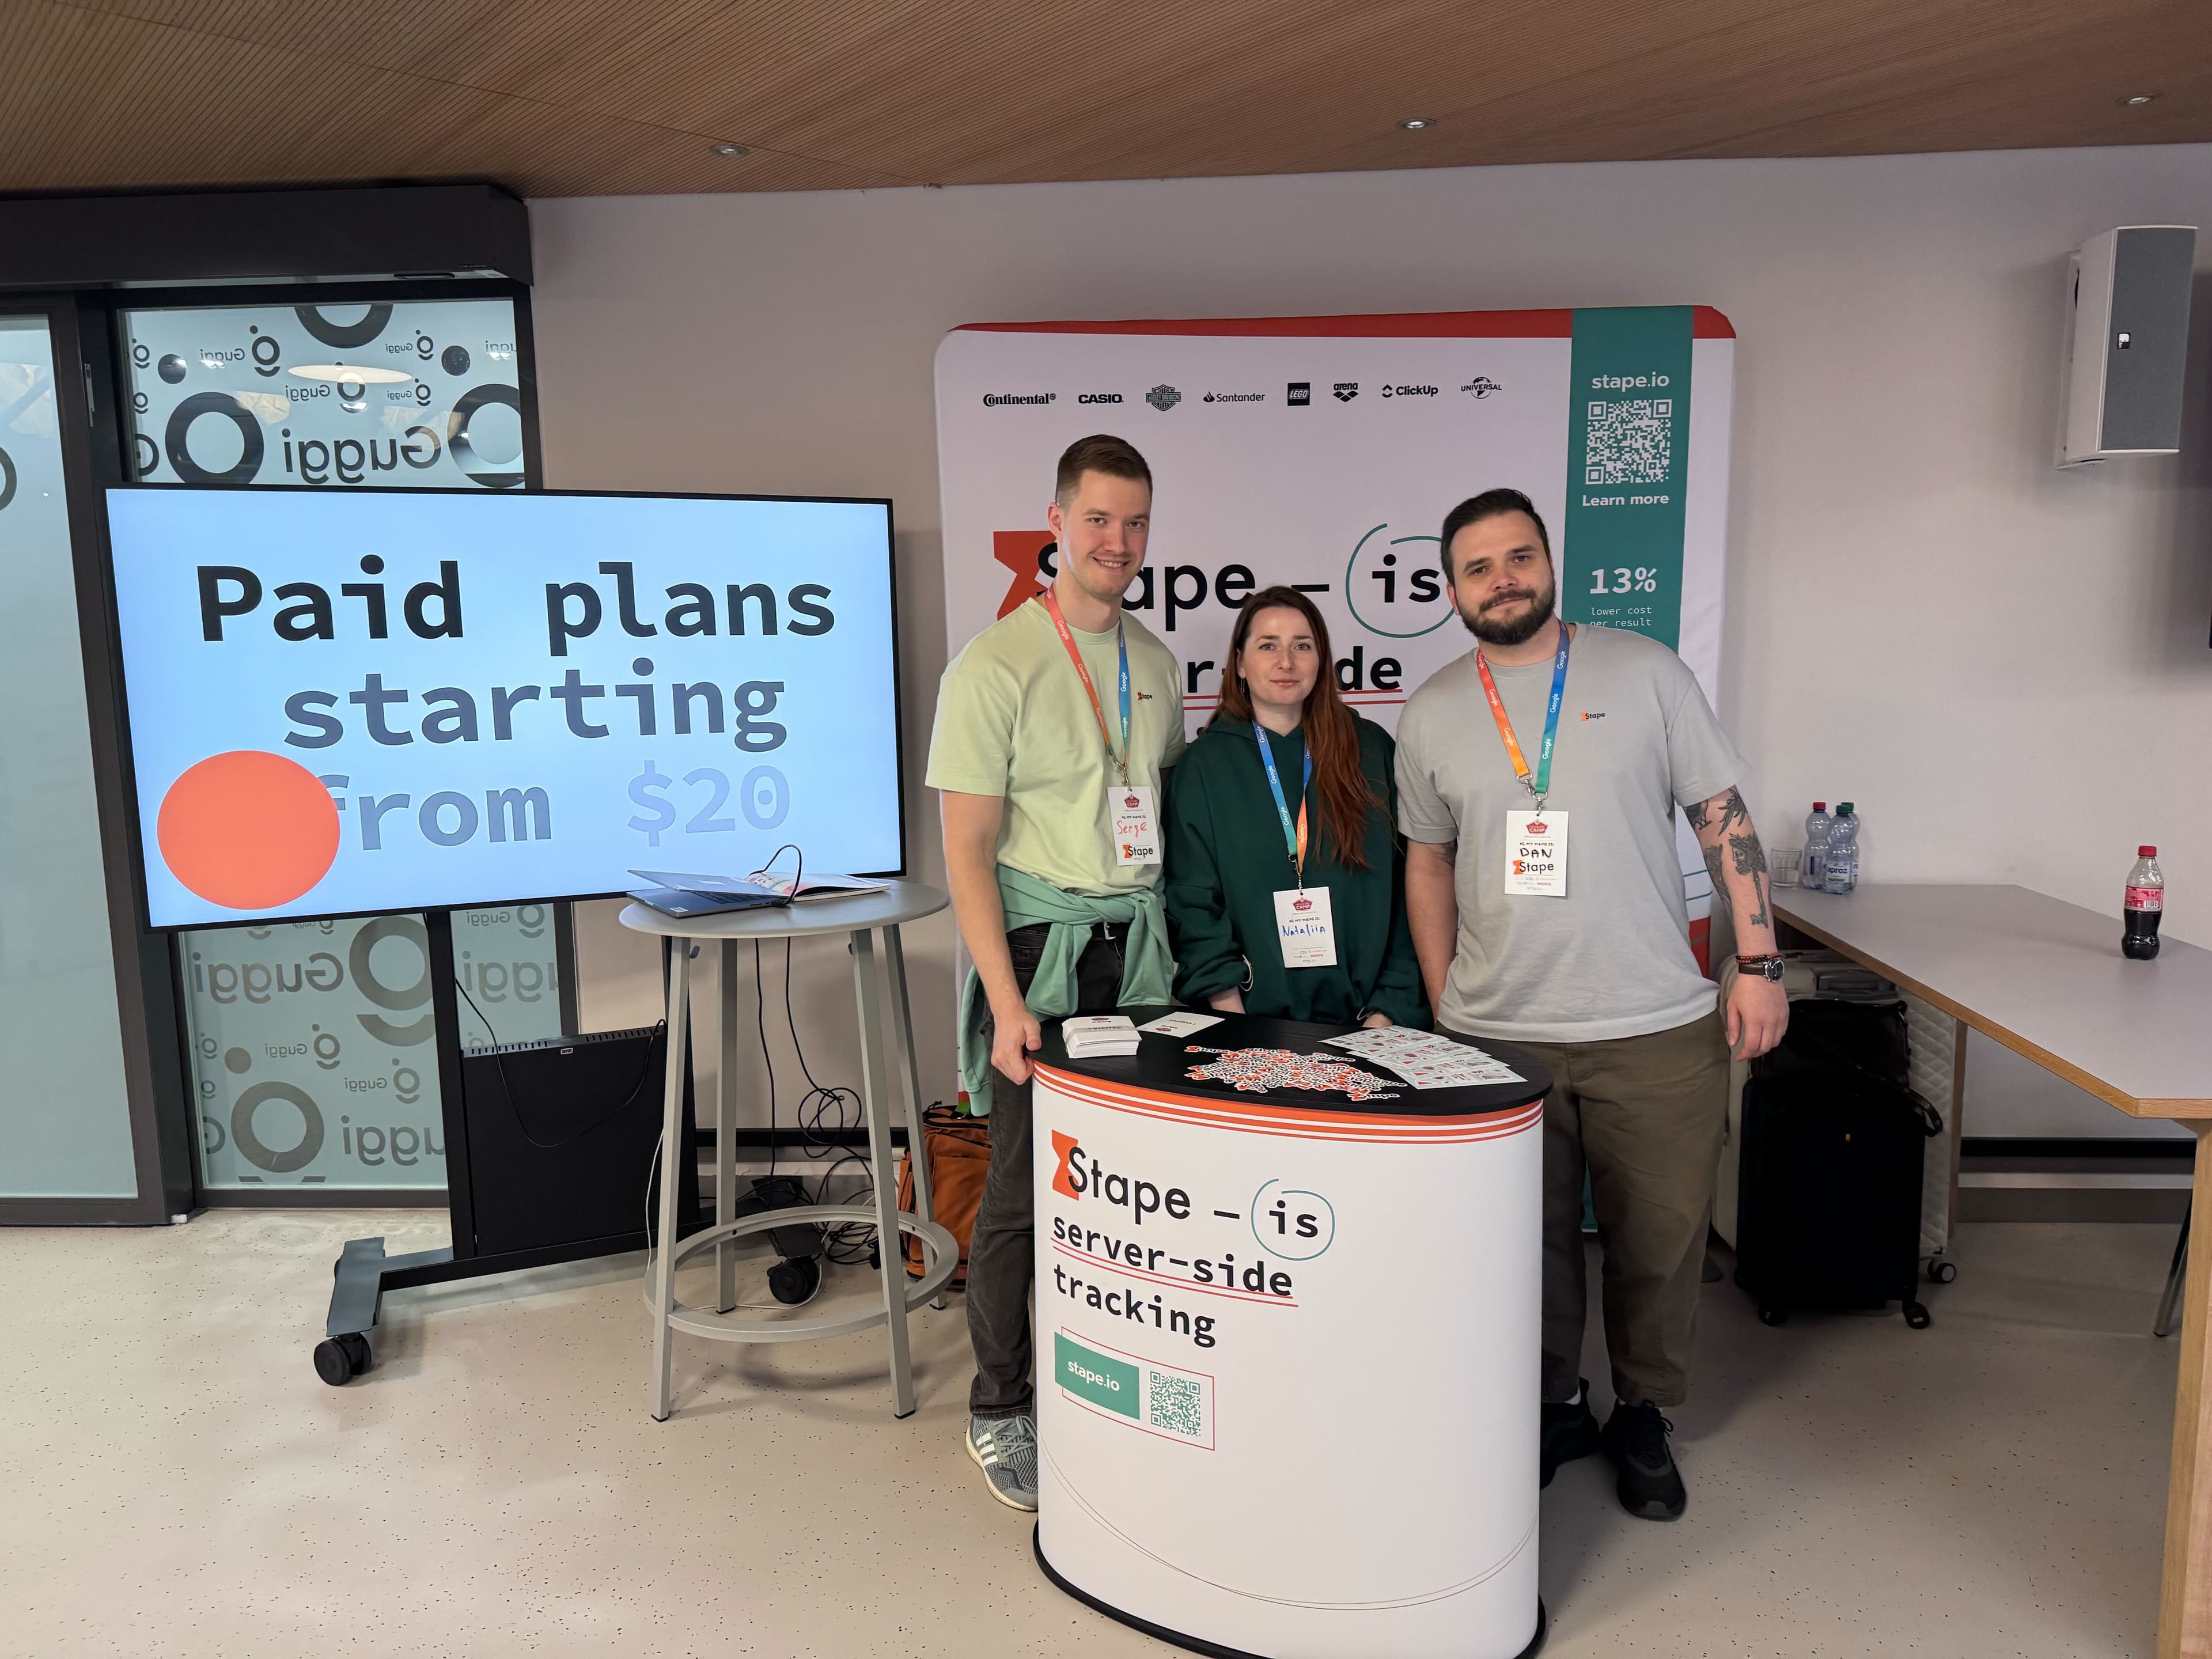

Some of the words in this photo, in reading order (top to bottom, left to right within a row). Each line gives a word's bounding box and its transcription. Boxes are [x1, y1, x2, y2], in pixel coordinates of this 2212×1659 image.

[1334, 382, 1358, 391] arena
[1396, 385, 1438, 397] ClickUp
[1461, 384, 1502, 392] UNIVERSAL
[1592, 372, 1669, 392] stape.io
[983, 393, 1050, 407] Continental
[1078, 394, 1123, 404] CASIO
[1217, 393, 1266, 402] Santander
[1289, 389, 1309, 399] LEGO
[1582, 495, 1624, 506] Learn
[1630, 495, 1669, 505] more
[1372, 554, 1440, 603] is
[1590, 567, 1657, 594] 13%
[197, 554, 463, 642] Paid
[545, 561, 835, 656] plans
[1590, 607, 1621, 615] lower
[1058, 620, 1069, 641] Google
[1615, 618, 1652, 626] result
[1557, 650, 1567, 669] Google
[285, 657, 787, 752] starting
[1550, 693, 1558, 713] Google
[1542, 738, 1551, 759] Google
[1267, 766, 1277, 784] Google
[627, 760, 790, 847] $20
[1281, 806, 1289, 825] Google
[1117, 820, 1147, 838] Serge
[1128, 846, 1153, 858] Stape
[1520, 847, 1552, 858] DAN
[1520, 862, 1554, 874] Stape
[1068, 1146, 1191, 1225] Stape
[1269, 1199, 1319, 1238] is
[1053, 1216, 1293, 1297] server-side
[1054, 1264, 1216, 1348] tracking
[1067, 1359, 1120, 1392] stape.io
